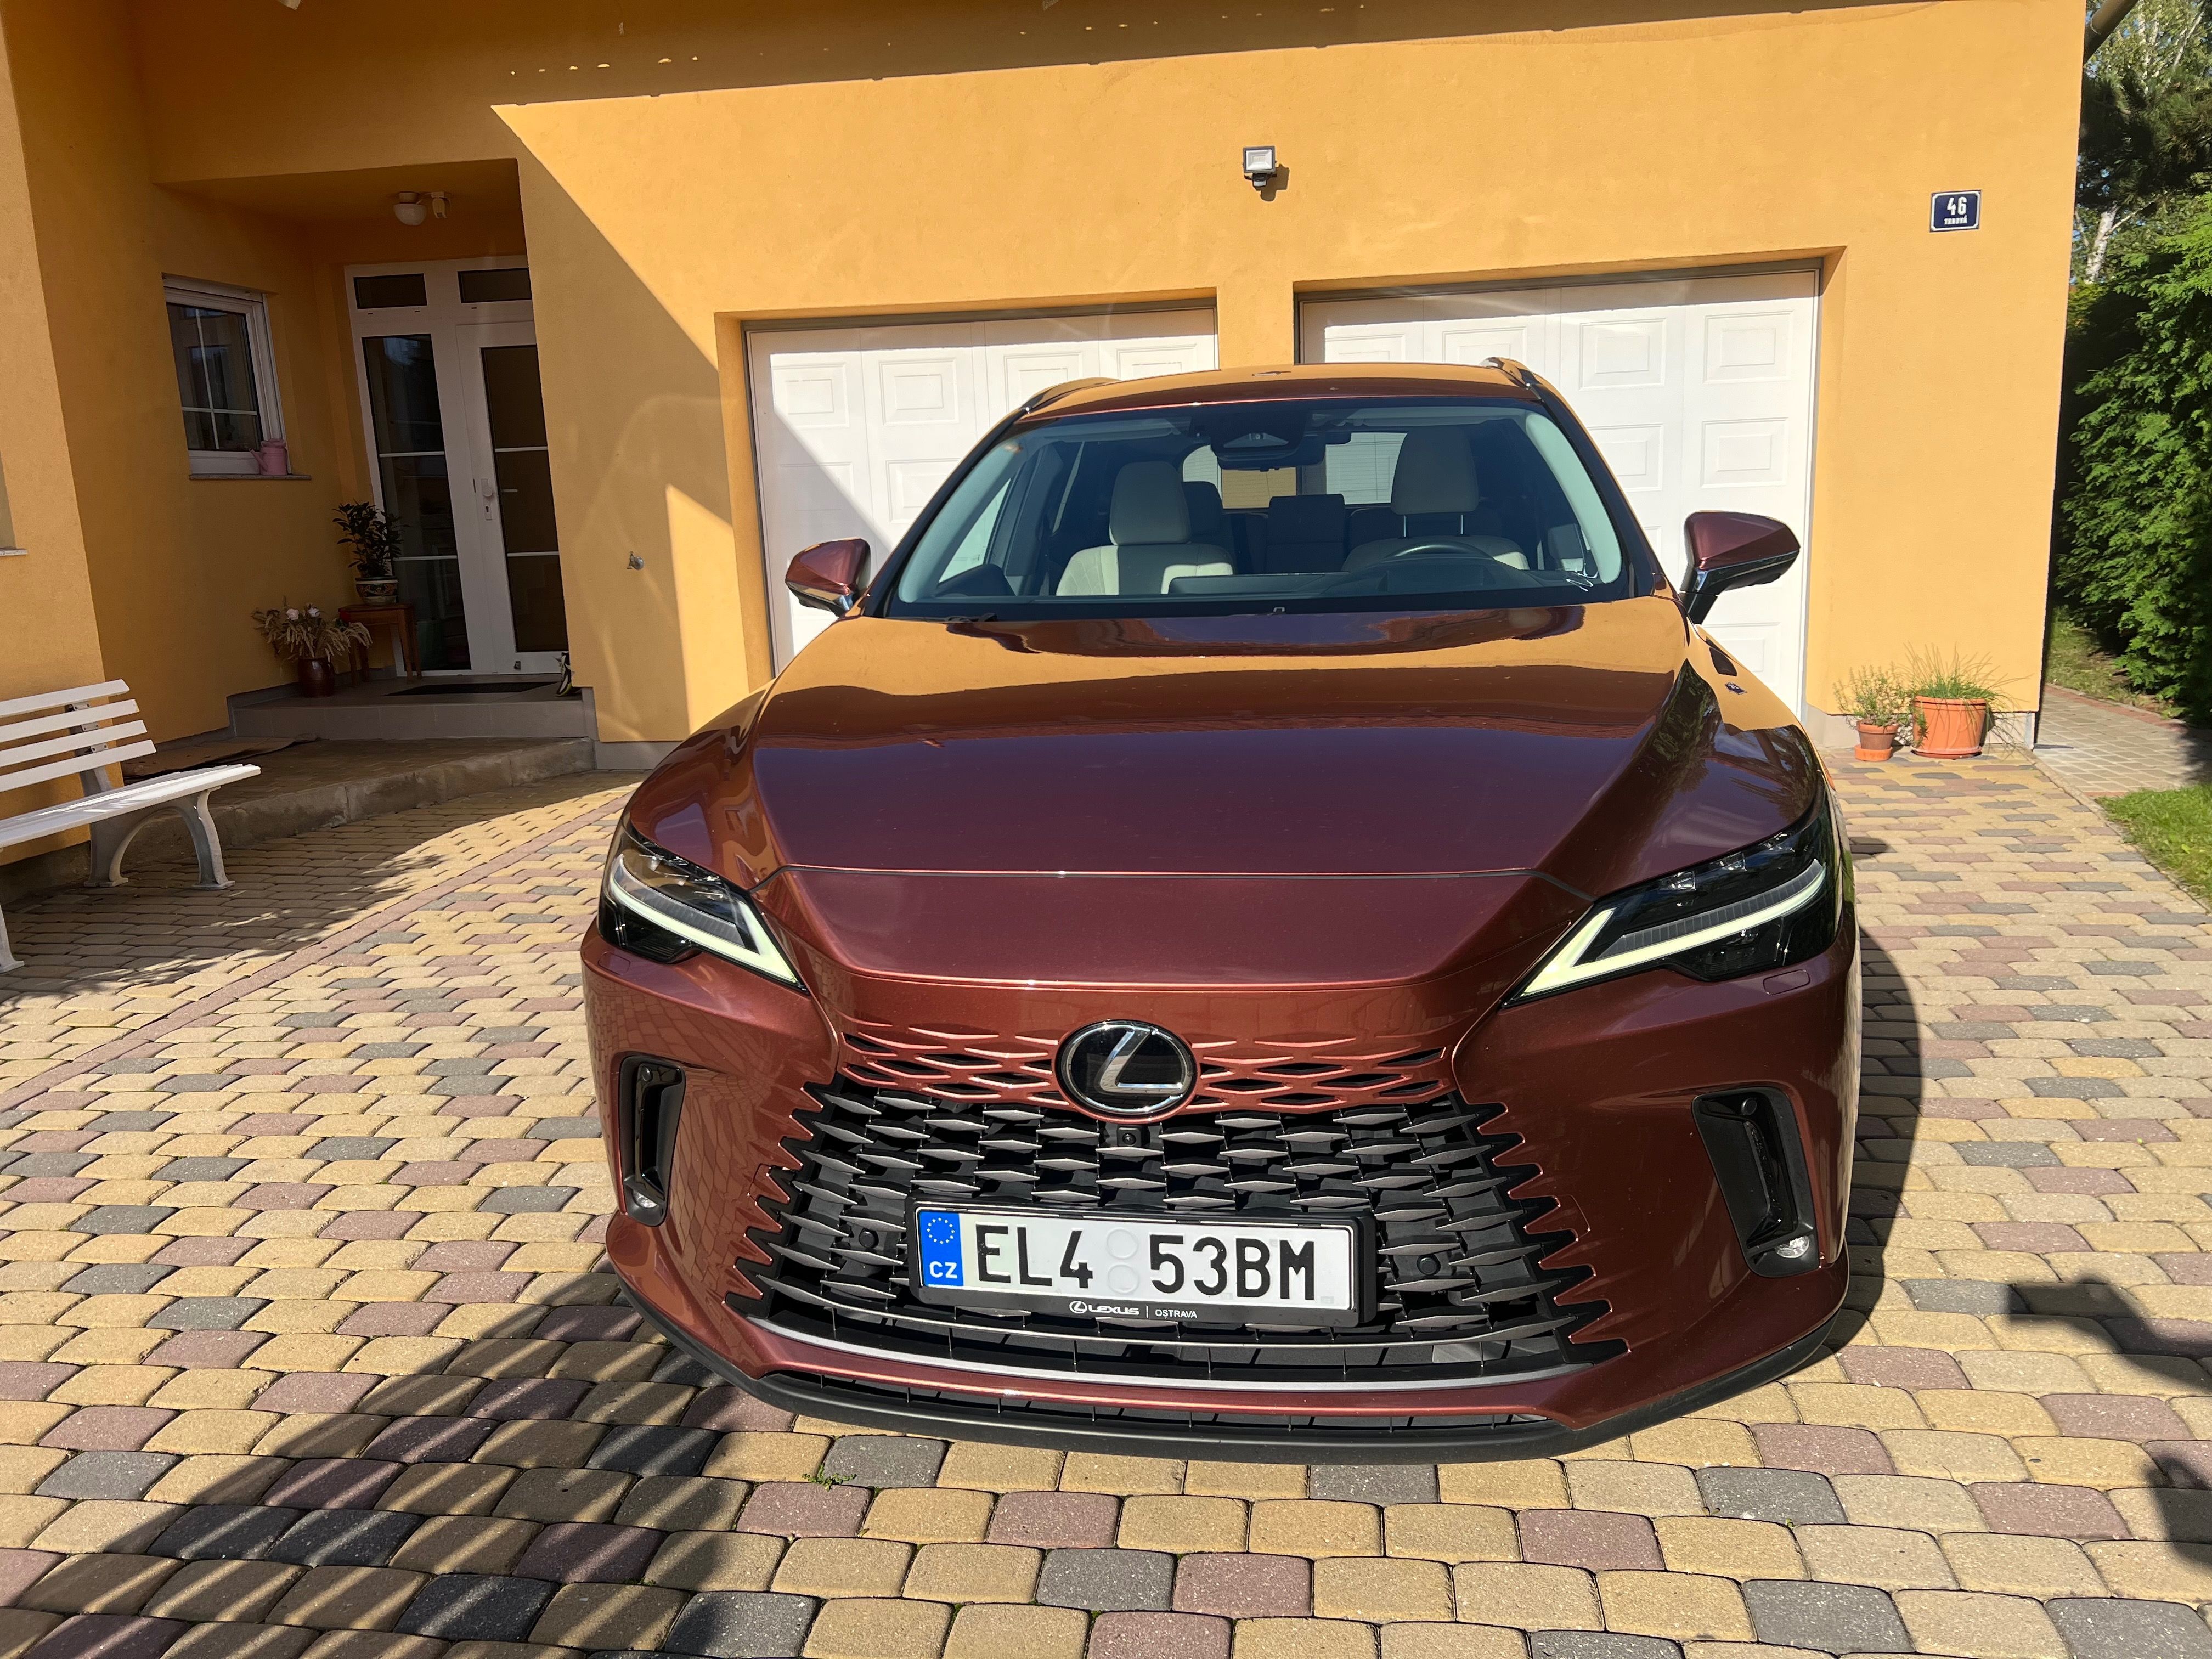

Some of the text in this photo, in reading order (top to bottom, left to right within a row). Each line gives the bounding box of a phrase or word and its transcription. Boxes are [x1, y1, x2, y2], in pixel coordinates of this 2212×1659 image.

[1947, 196, 1967, 216] 46
[929, 1261, 958, 1279] CZ
[975, 1224, 1315, 1301] EL4 53BM
[1088, 1304, 1198, 1318] LEXUS OSTRAVA
